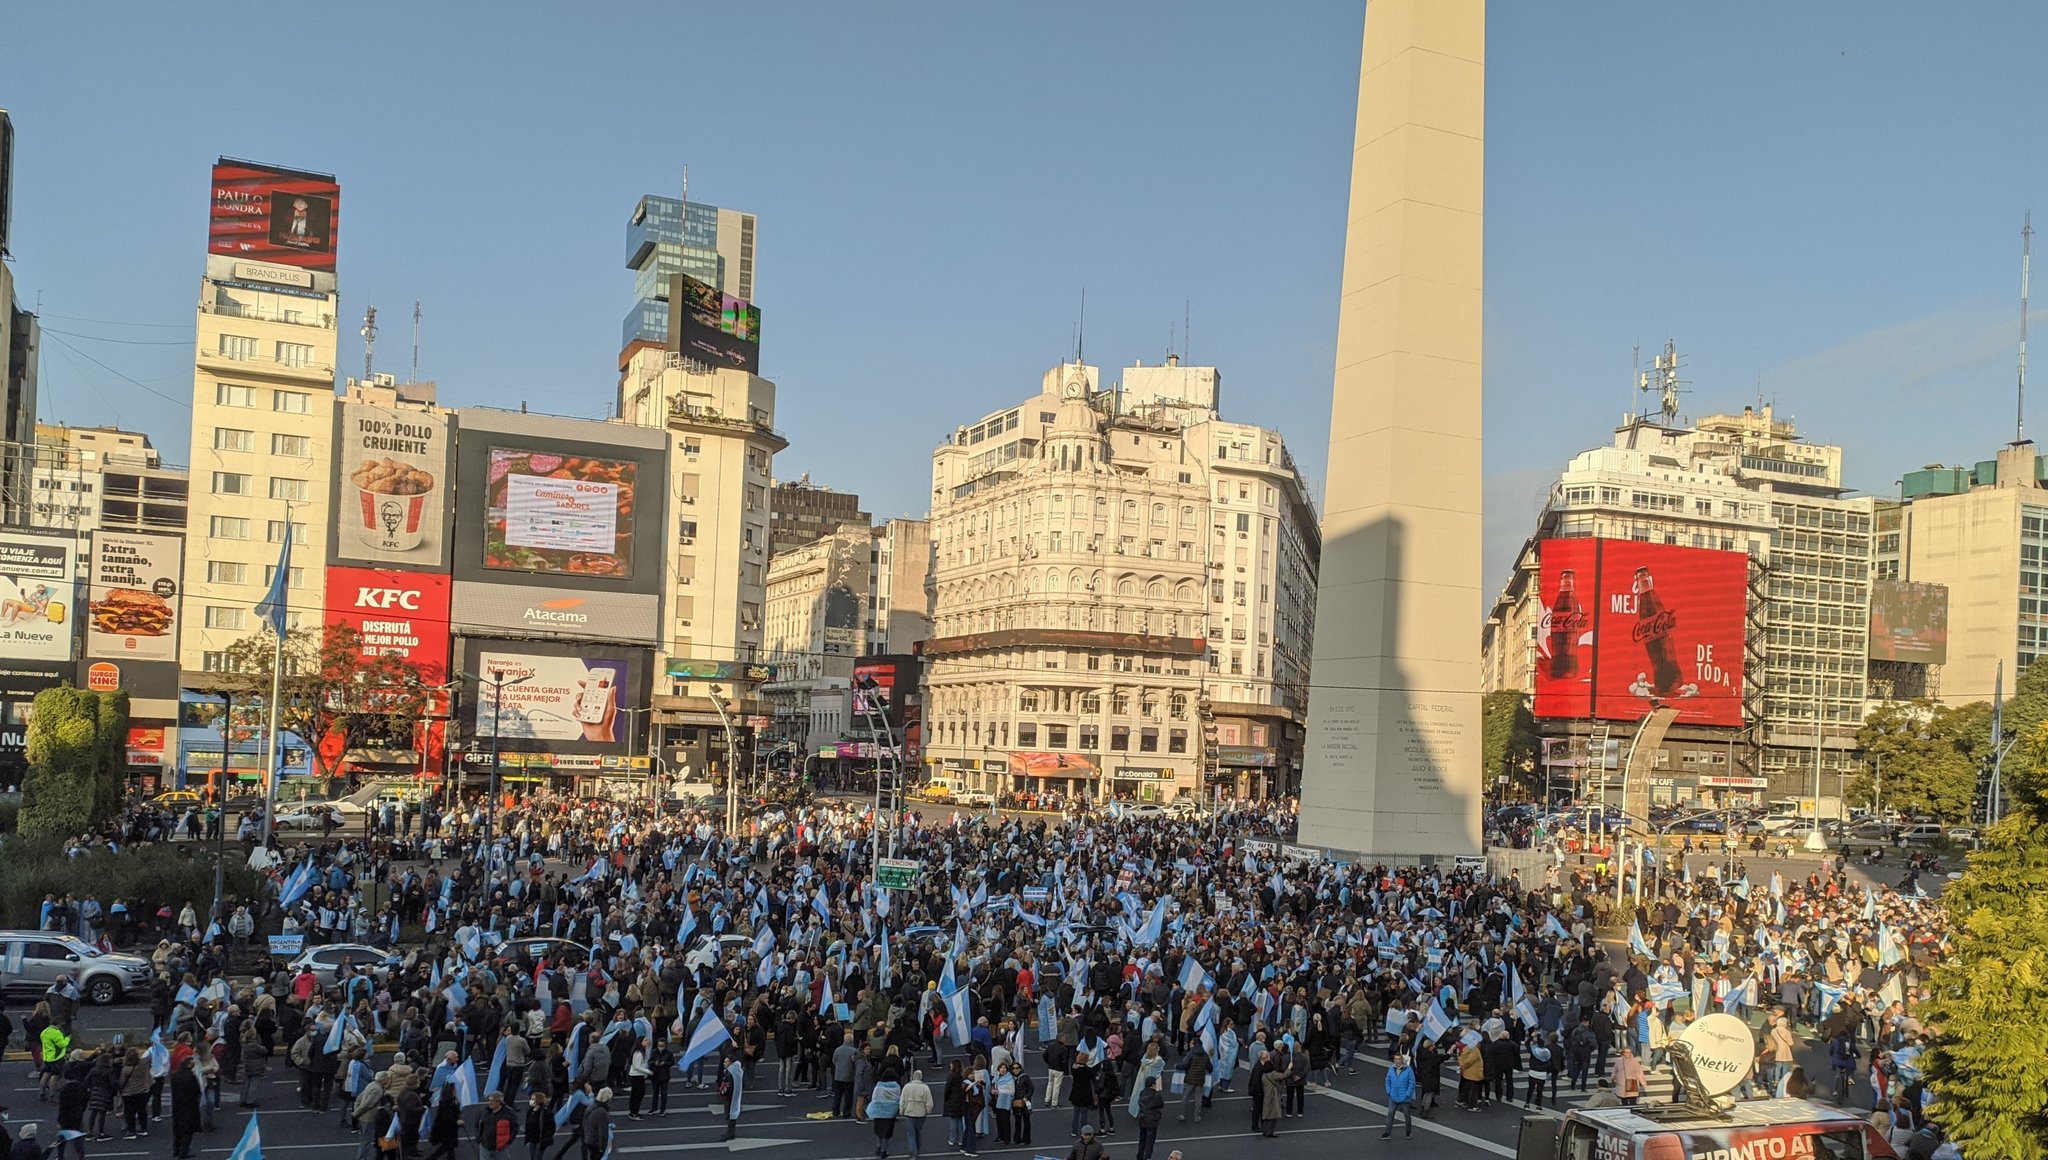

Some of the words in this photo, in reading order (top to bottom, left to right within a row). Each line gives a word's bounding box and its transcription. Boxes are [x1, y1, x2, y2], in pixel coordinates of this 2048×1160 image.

[217, 189, 263, 205] PAULO
[217, 201, 263, 215] LONDRA
[246, 268, 278, 279] BRAND
[279, 271, 300, 282] PLUS
[359, 419, 392, 435] 100%
[395, 423, 432, 439] POLLO
[363, 436, 427, 455] CRUJIENTE
[535, 488, 569, 500] Caminos
[556, 501, 592, 511] SABORES
[102, 544, 136, 554] Extra
[382, 540, 400, 548] KFC
[9, 547, 35, 556] VIAJE
[41, 556, 63, 565] AQUÍ
[102, 554, 152, 567] tamaño,
[101, 565, 134, 574] extra
[100, 574, 146, 586] manija.
[354, 587, 421, 610] KFC
[523, 608, 587, 623] Atacama
[1541, 611, 1589, 630] Coca-Cola
[362, 620, 411, 634] DISFRUTÁ
[1632, 608, 1677, 643] Coca-Cola
[15, 631, 53, 641] Nueve
[365, 635, 391, 645] MEJOR
[393, 636, 419, 646] POLLO
[1696, 644, 1713, 663] DE
[488, 658, 513, 666] Naranja
[90, 677, 117, 686] KING
[507, 685, 540, 693] CUENTA
[541, 687, 571, 695] GRATIS
[510, 694, 532, 702] USAR
[533, 695, 561, 703] MEJOR
[1118, 770, 1158, 778] McDonald's
[1650, 777, 1658, 785] DE
[1694, 1054, 1738, 1073] iNetVu
